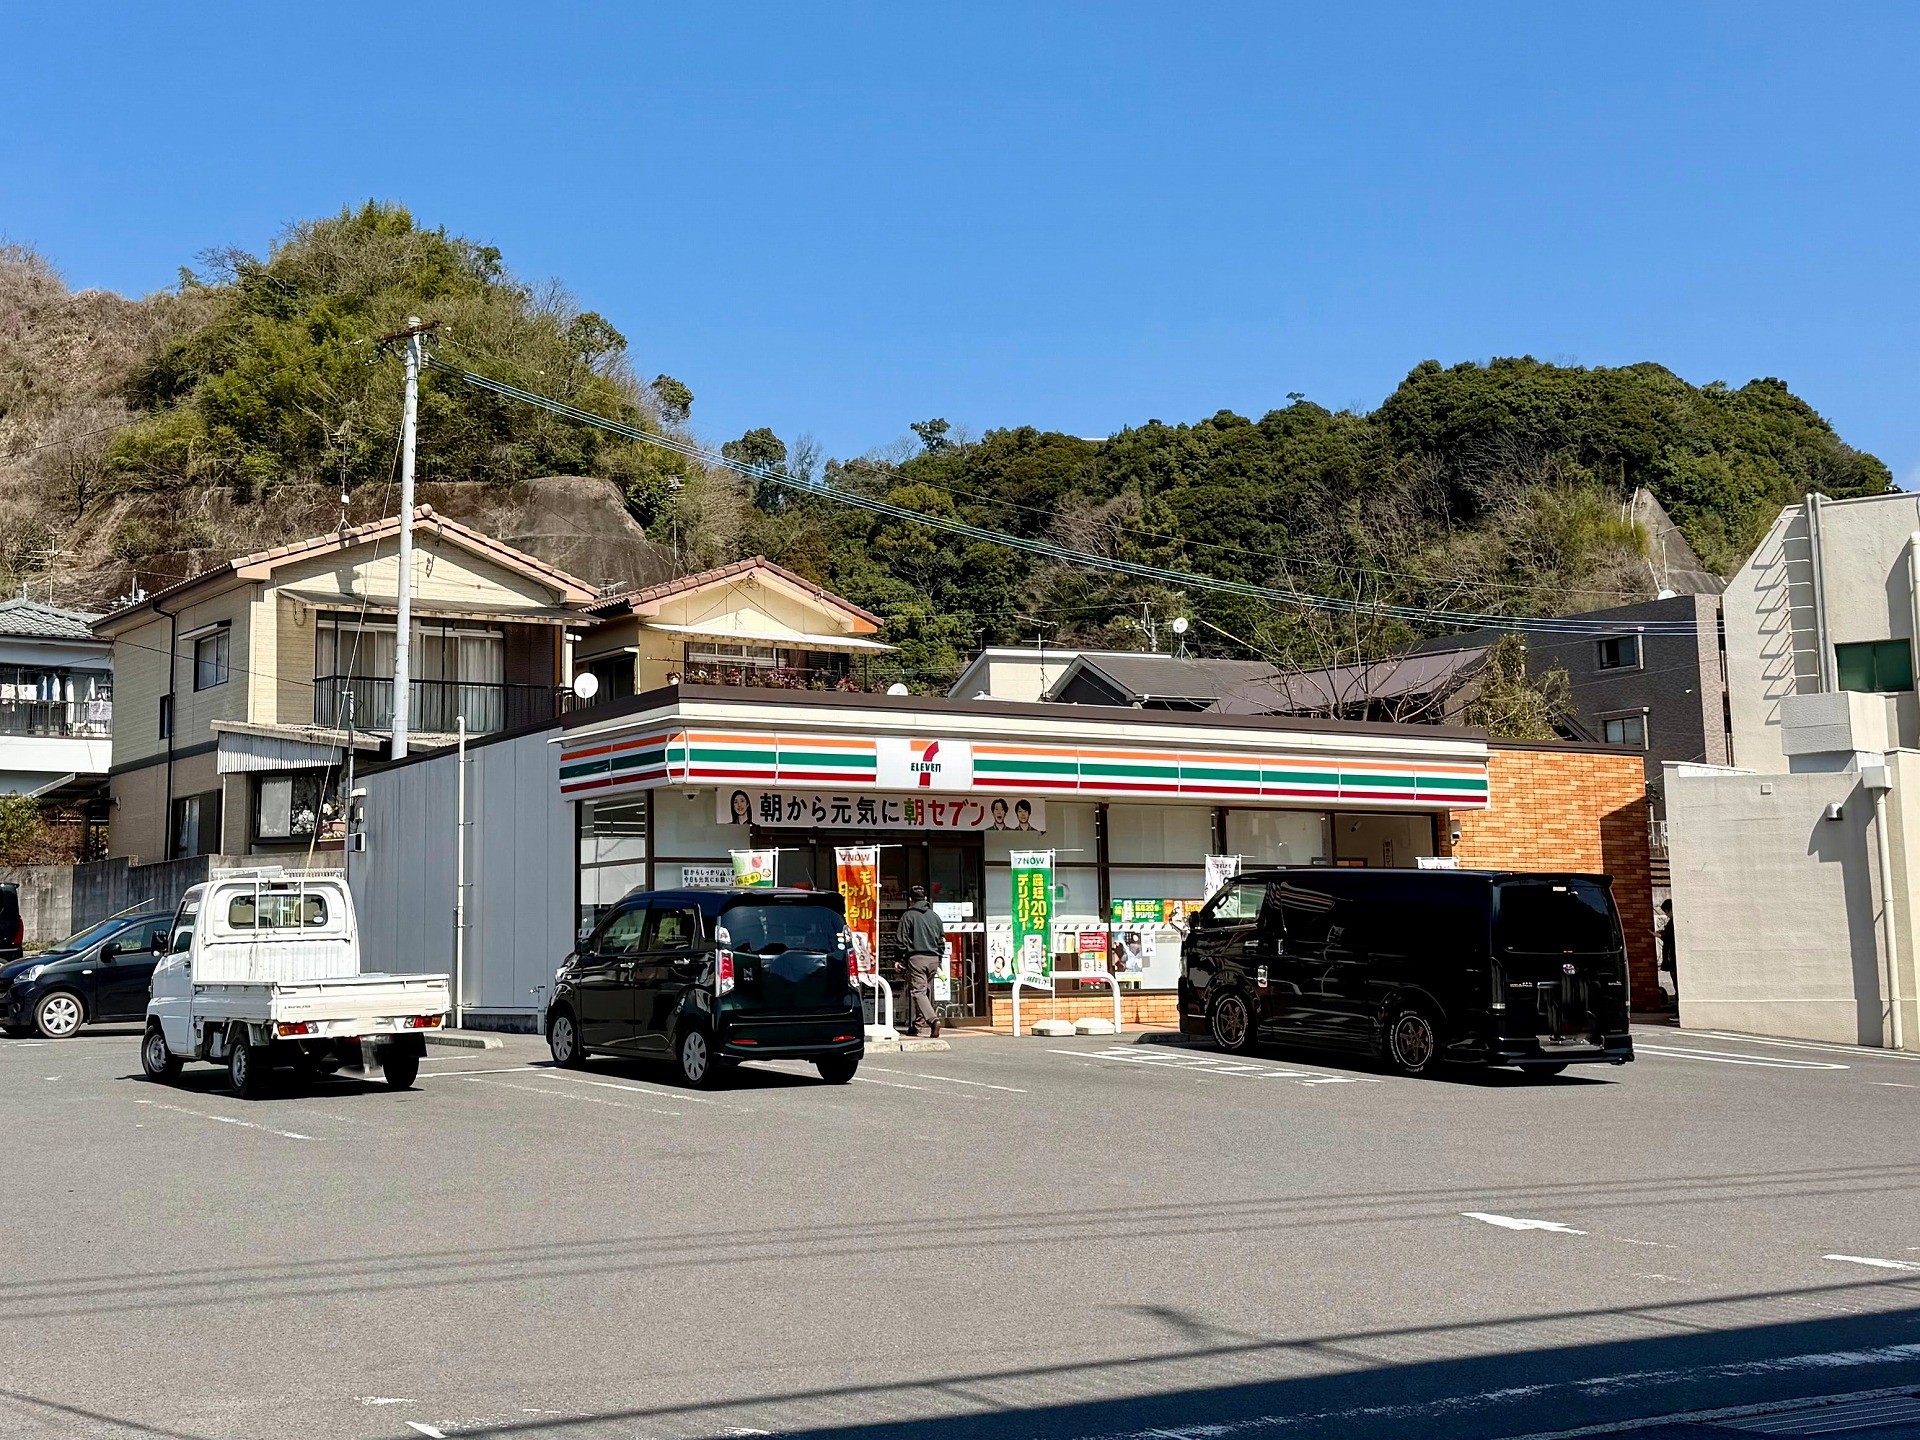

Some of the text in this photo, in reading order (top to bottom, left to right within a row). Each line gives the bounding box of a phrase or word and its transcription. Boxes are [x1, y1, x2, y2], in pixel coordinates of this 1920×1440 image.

[760, 792, 985, 827] 朝から元気に朝セブン
[1017, 857, 1045, 866] 7NOW
[849, 886, 861, 928] オーダー
[860, 870, 872, 920] モバイル
[1018, 873, 1030, 931] デリバリー
